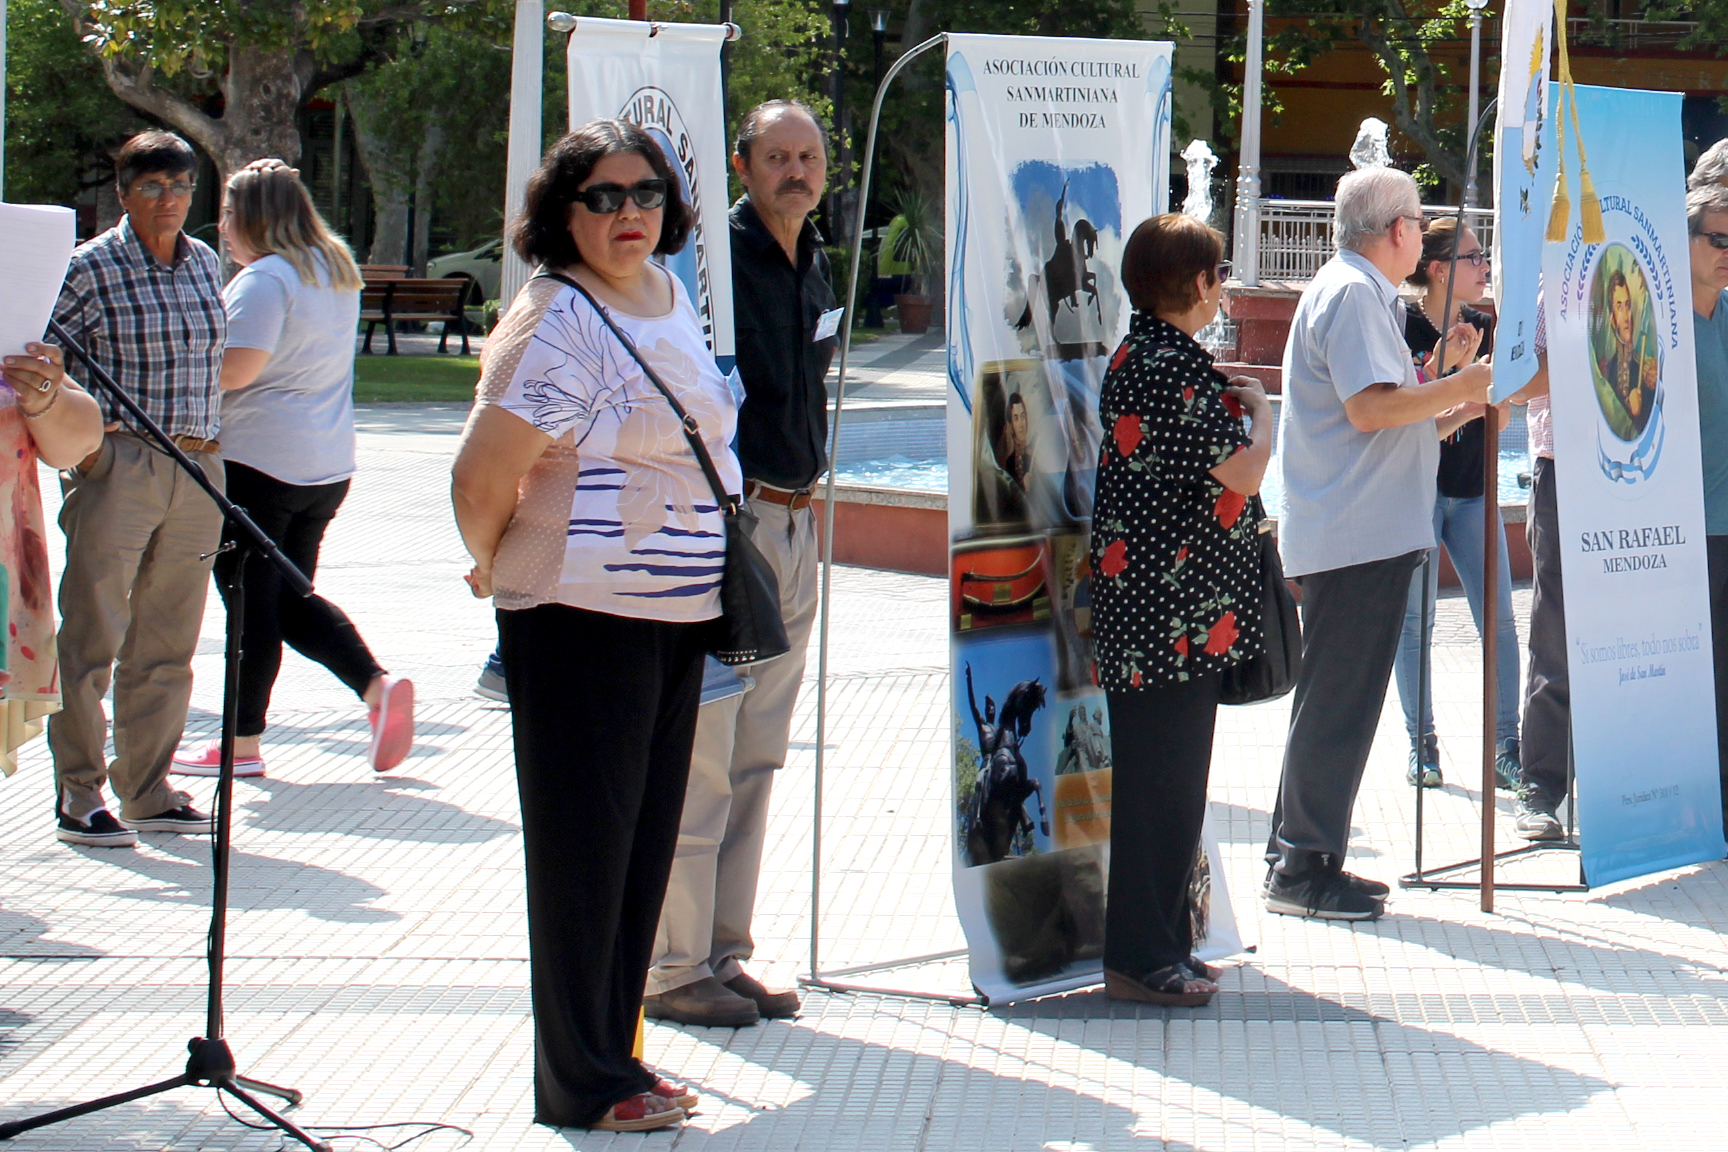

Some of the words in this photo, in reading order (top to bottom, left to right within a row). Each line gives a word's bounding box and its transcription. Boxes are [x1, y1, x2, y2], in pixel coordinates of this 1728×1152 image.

[983, 56, 1068, 76] ASOCIACIÓN
[1071, 61, 1140, 78] CULTURAL
[1006, 85, 1118, 103] SANMARTINIANA
[623, 95, 672, 137] URAL
[1019, 112, 1038, 129] DE
[1042, 112, 1106, 129] MENDOZA
[1560, 222, 1583, 323] ASOCIACIÓ
[1599, 195, 1632, 216] LTURAL
[1633, 206, 1678, 350] SANMARTINIANA
[1581, 530, 1614, 553] SAN
[1618, 525, 1686, 549] RAFAEL
[1603, 553, 1667, 574] MENDOZA
[1590, 645, 1616, 663] somos
[1616, 637, 1641, 659] libres,
[1641, 632, 1660, 656] todo
[1662, 637, 1677, 654] nos
[1630, 667, 1636, 680] de
[1637, 665, 1647, 680] San
